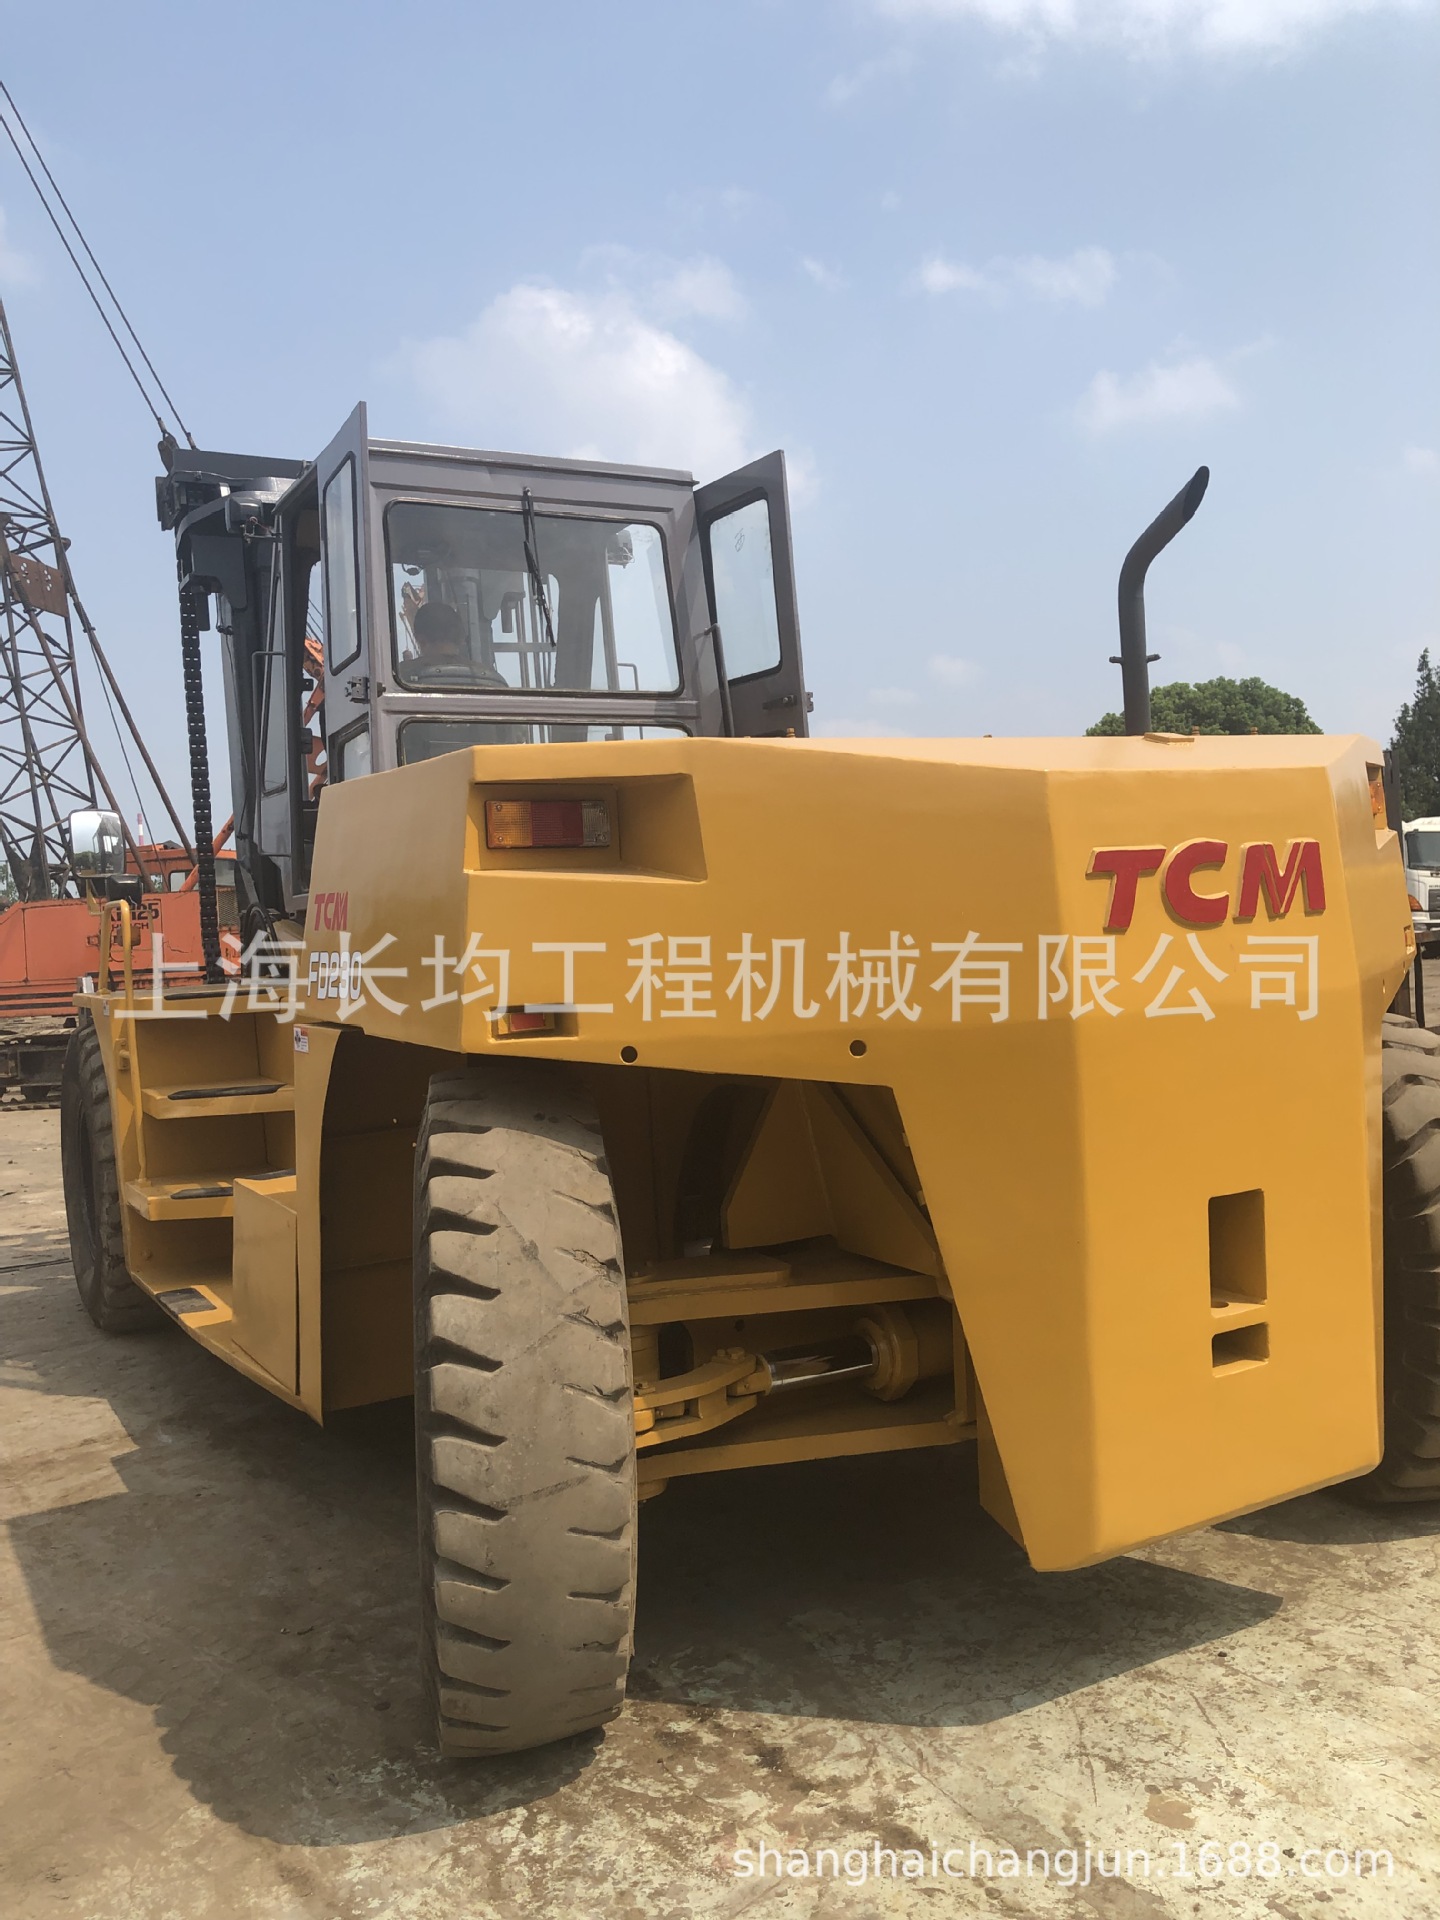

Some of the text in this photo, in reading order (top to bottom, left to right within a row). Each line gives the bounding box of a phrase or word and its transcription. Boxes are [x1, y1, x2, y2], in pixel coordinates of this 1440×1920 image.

[314, 891, 349, 931] TCM
[1086, 838, 1326, 935] TCM
[307, 951, 362, 1000] FD230
